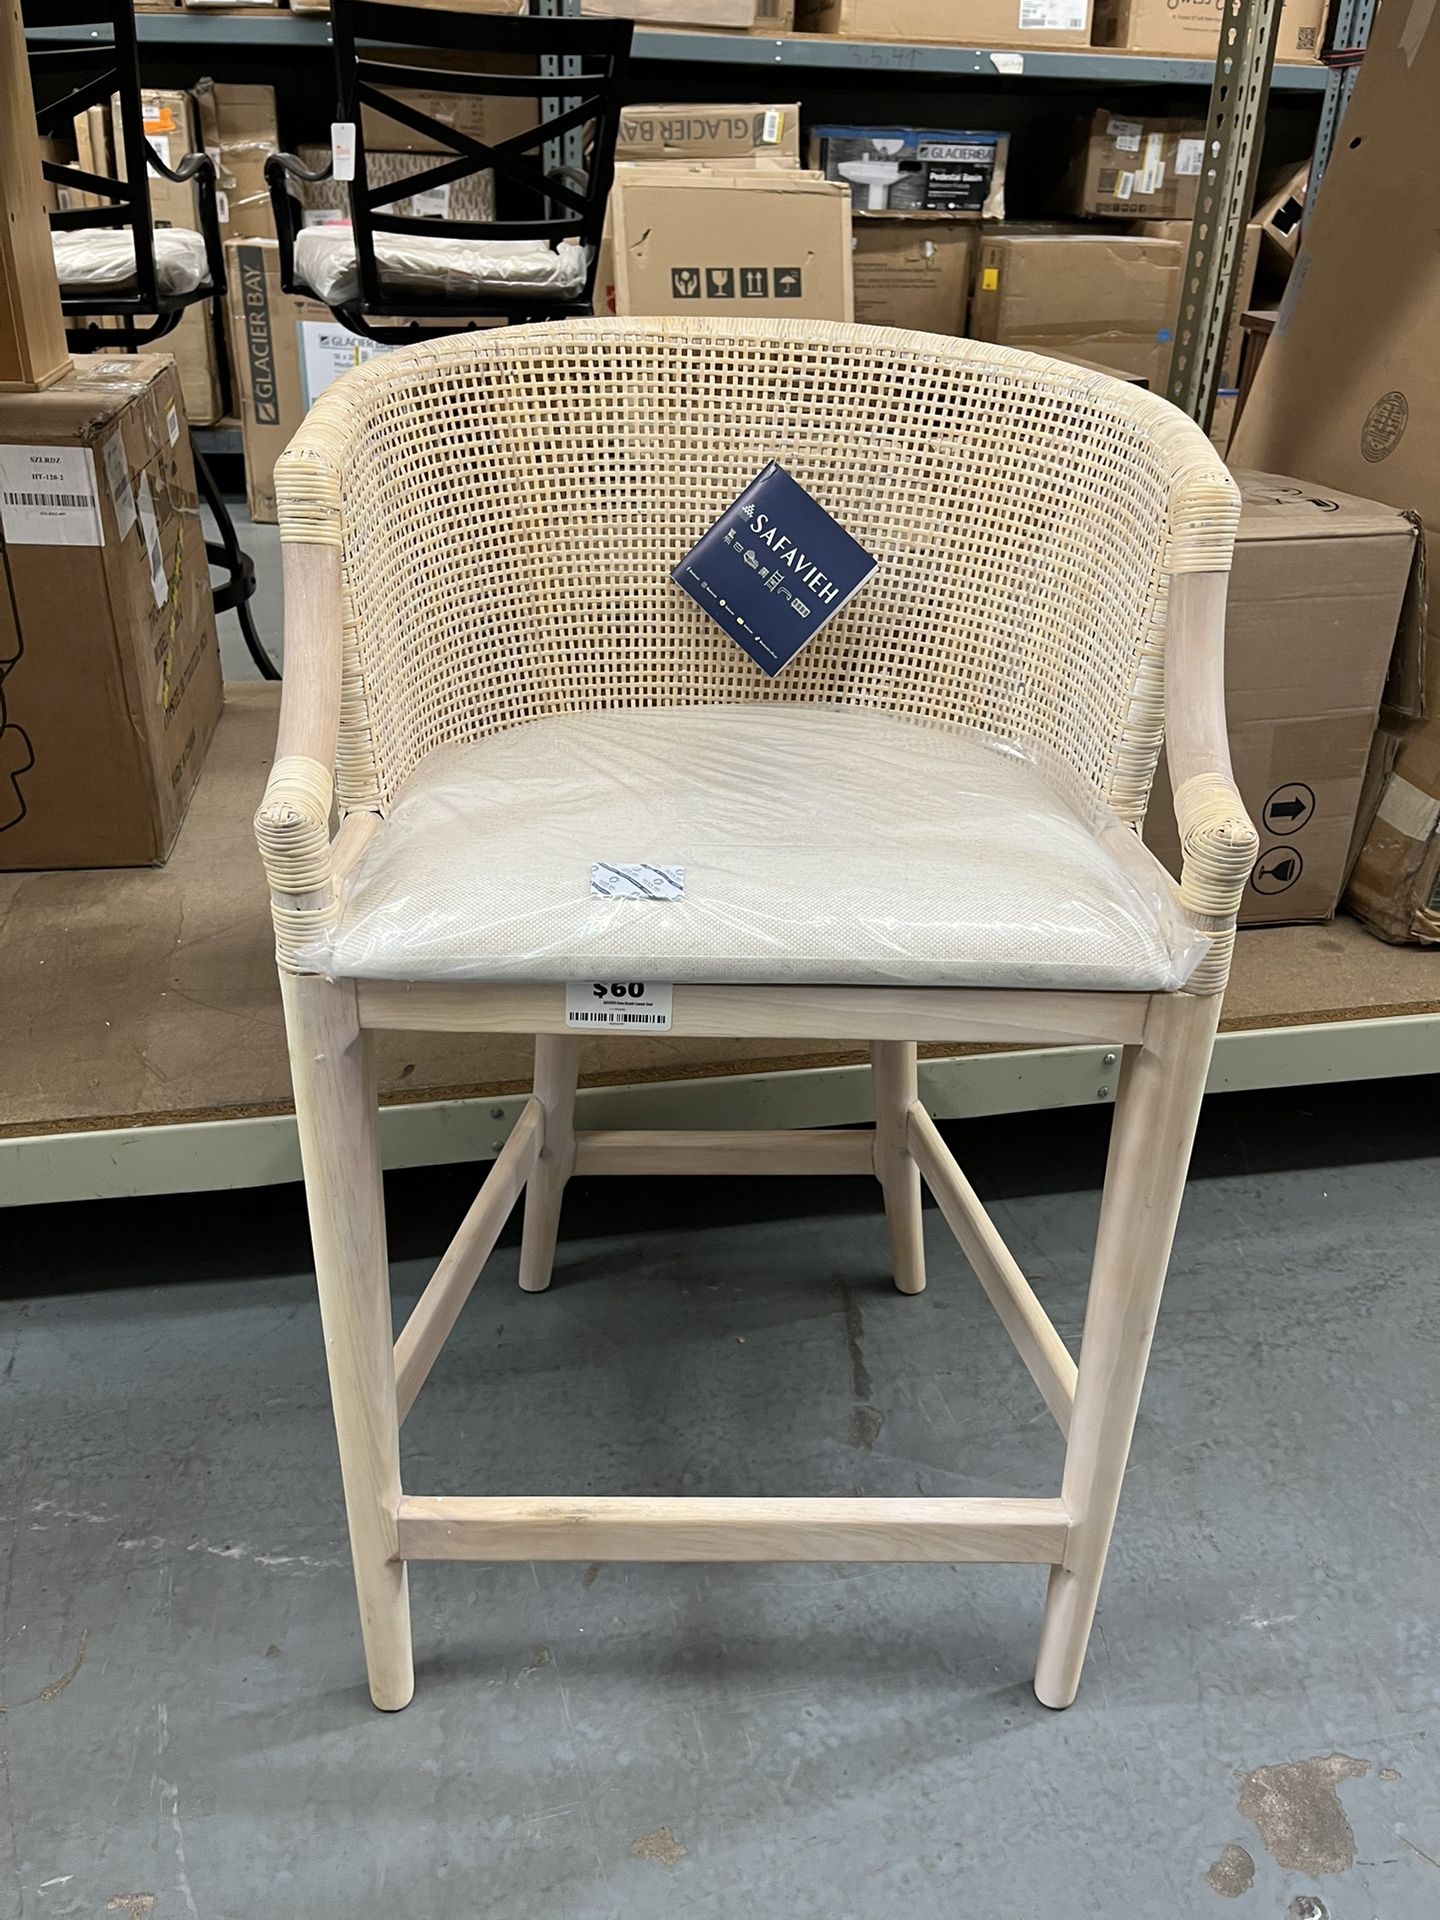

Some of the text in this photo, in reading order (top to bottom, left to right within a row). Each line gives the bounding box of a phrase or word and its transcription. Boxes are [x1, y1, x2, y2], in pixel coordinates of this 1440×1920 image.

[660, 118, 748, 140] GLACIER
[931, 147, 976, 160] GLACIER
[243, 264, 273, 398] GLACIER BAY
[750, 514, 839, 604] SAFAVIEH
[593, 983, 645, 998] $60
